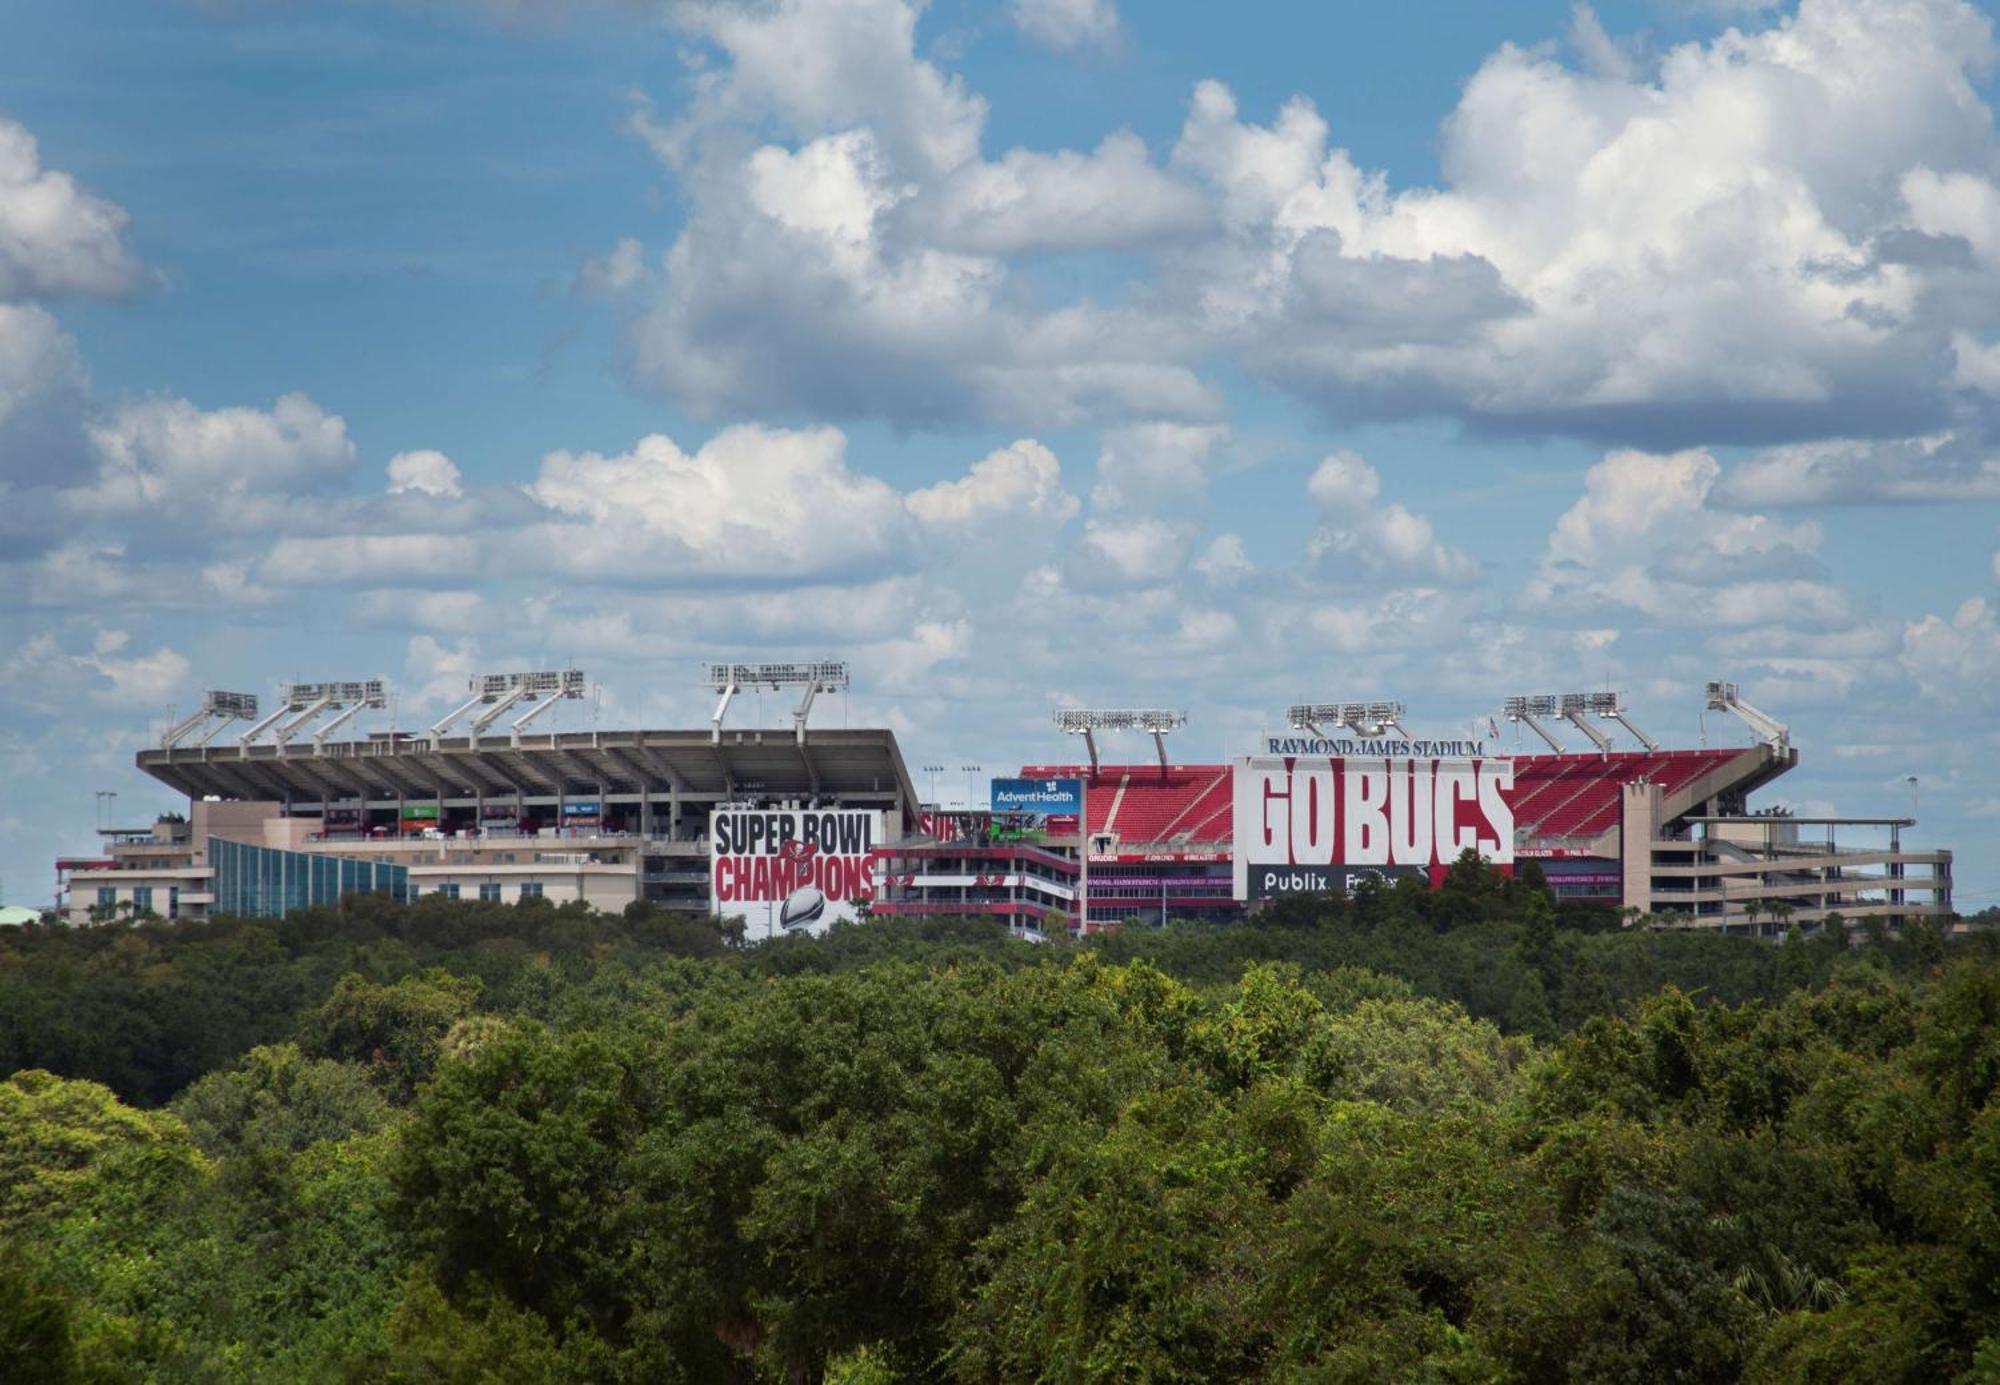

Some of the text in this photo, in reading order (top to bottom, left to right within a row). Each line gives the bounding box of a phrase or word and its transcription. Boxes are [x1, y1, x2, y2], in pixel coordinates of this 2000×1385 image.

[1269, 738, 1483, 756] RAYMOND JAMES STADIUM
[997, 790, 1074, 802] AdventHealth
[1246, 757, 1514, 865] GO BUCS
[715, 814, 872, 855] SUPER BOWL
[715, 856, 876, 902] CHAMPIONS
[1264, 872, 1327, 891] Publix
